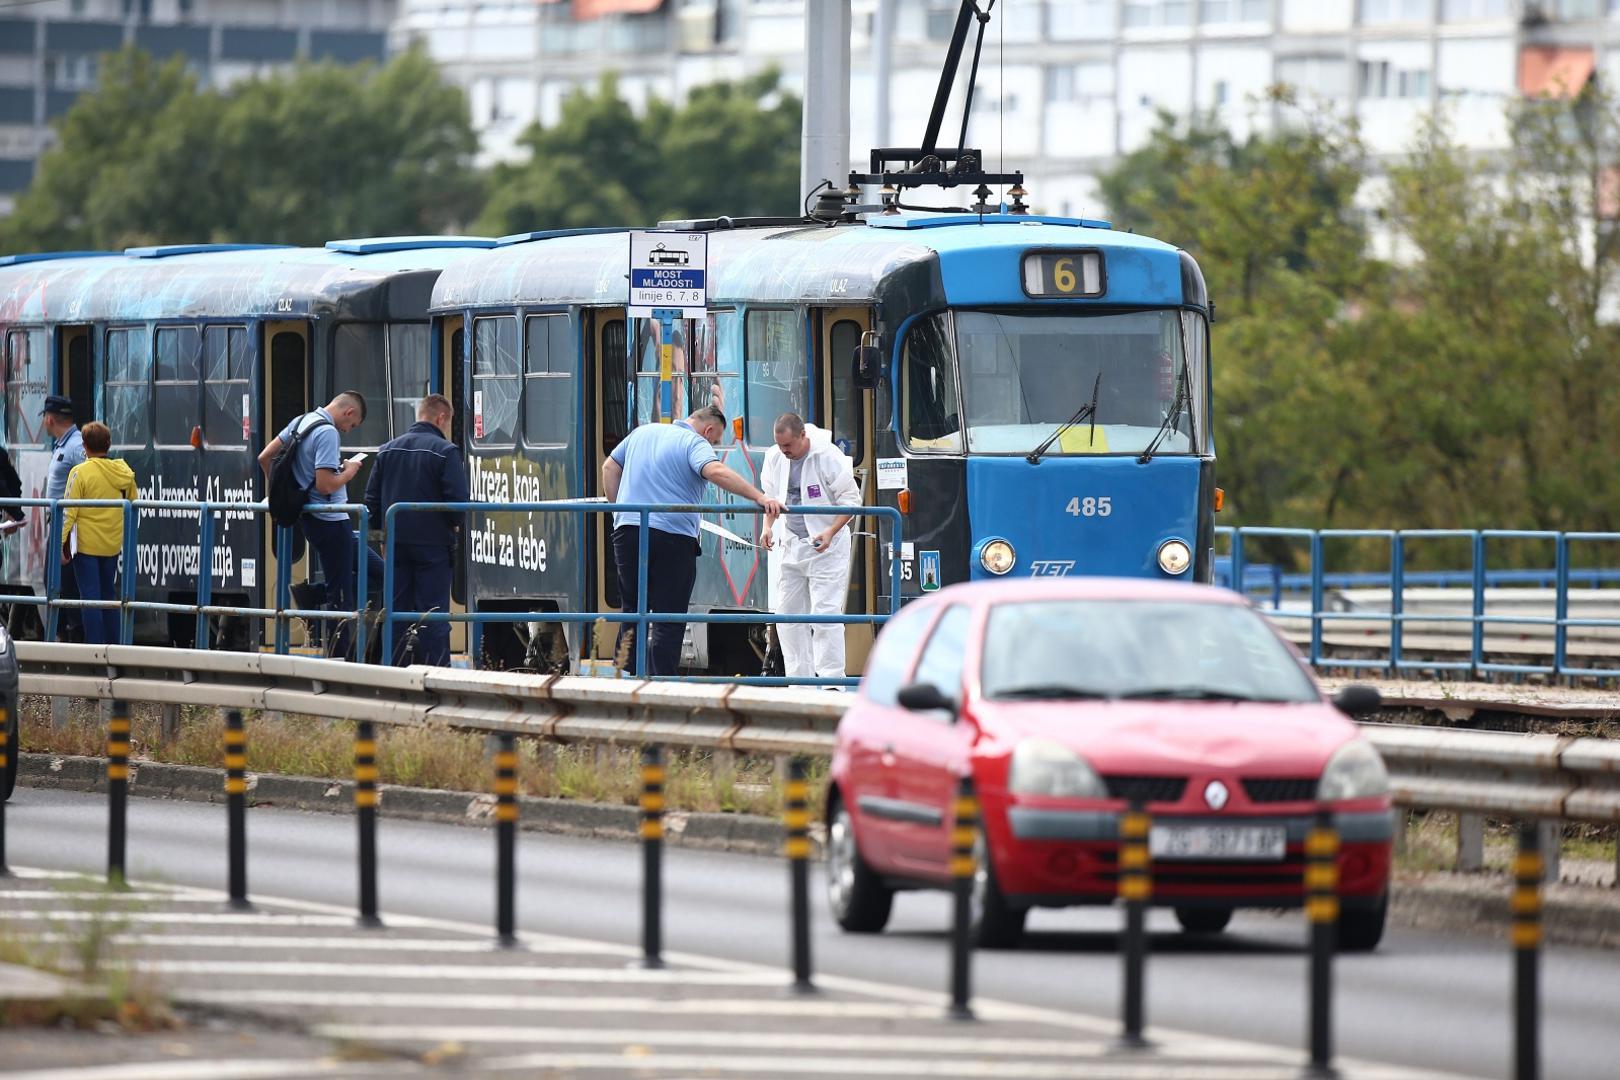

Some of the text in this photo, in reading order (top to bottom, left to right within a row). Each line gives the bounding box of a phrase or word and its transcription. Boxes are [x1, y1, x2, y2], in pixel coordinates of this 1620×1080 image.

[642, 279, 693, 288] MLADOSTI
[654, 270, 682, 278] MOST
[1054, 257, 1077, 293] 6
[831, 278, 848, 293] ULAZ
[638, 290, 663, 303] linije
[692, 291, 699, 302] 8
[469, 455, 540, 519] Mreža koja
[205, 475, 221, 519] A1
[224, 478, 254, 531] prati
[1065, 496, 1112, 517] 485
[470, 518, 547, 573] radi za tebe
[1030, 560, 1076, 578] ZET
